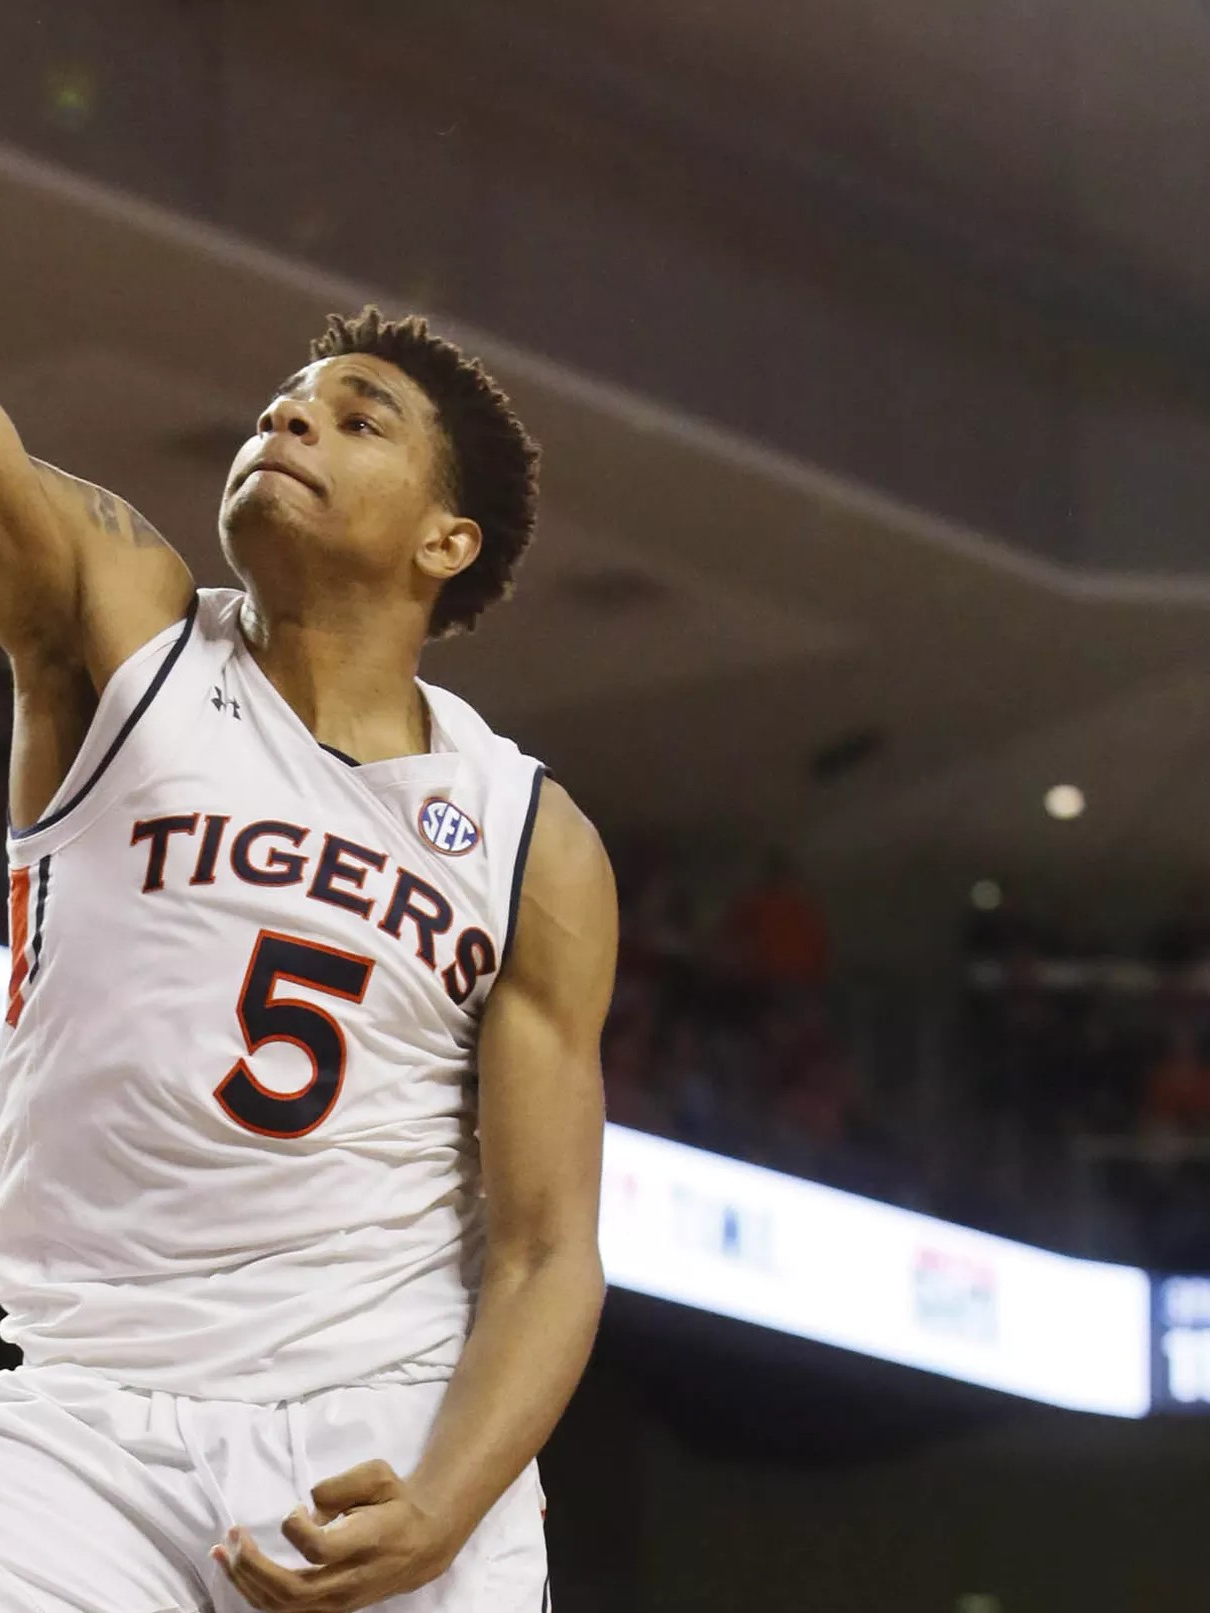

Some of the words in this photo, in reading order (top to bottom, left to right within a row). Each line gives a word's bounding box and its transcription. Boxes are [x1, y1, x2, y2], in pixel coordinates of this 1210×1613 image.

[130, 812, 498, 1006] TIGERS
[421, 801, 476, 852] SEC
[213, 928, 376, 1139] 5
